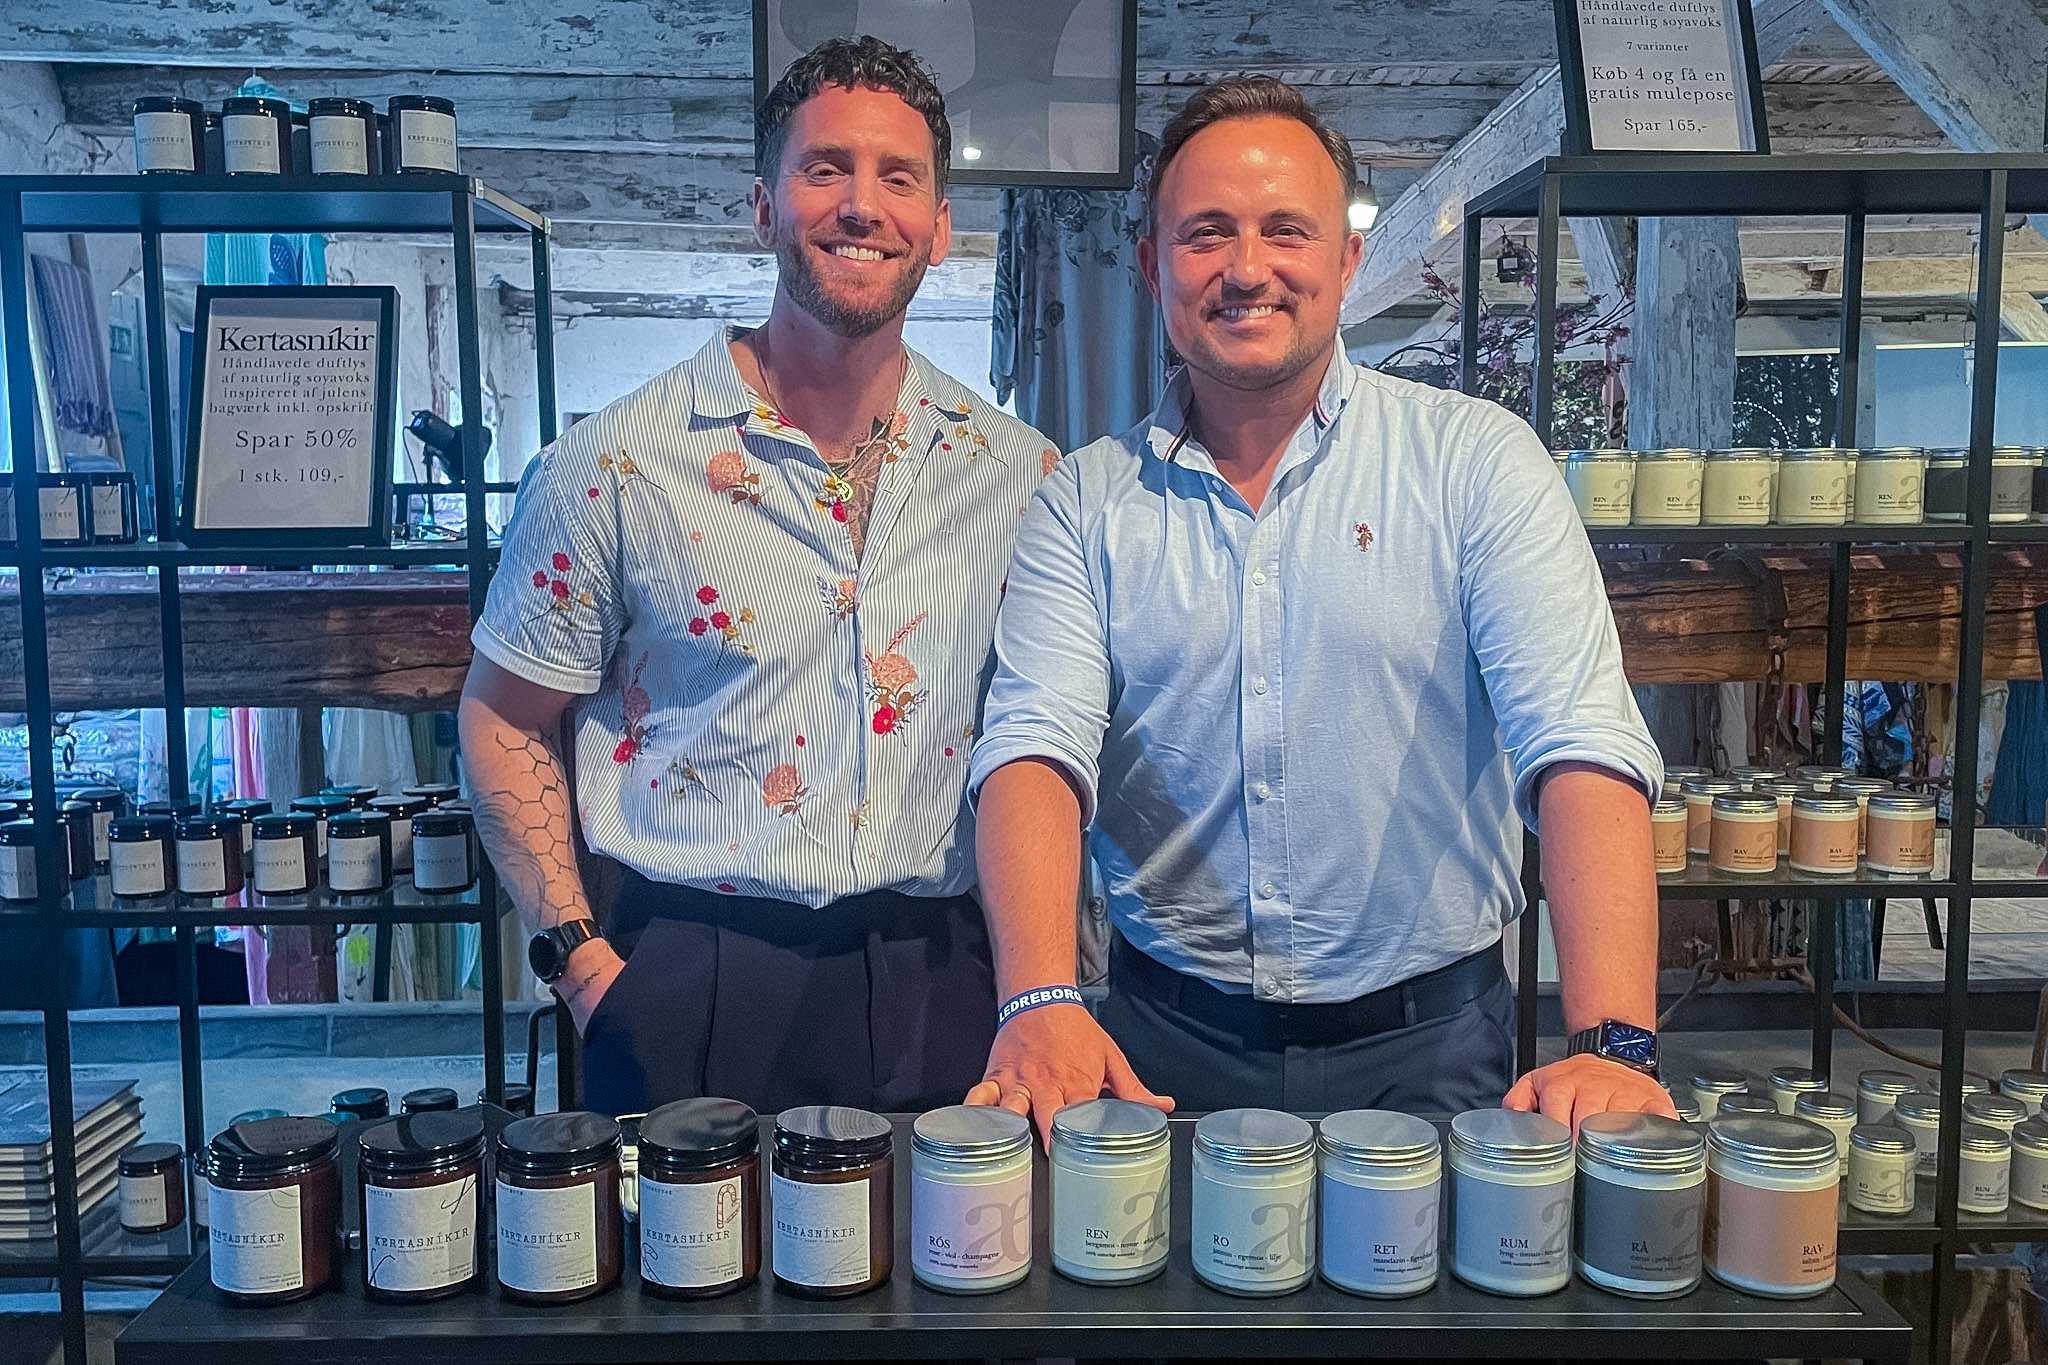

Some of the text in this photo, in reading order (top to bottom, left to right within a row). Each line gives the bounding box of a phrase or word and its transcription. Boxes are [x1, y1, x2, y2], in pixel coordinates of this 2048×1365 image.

[1669, 1, 1715, 15] duftlys
[1583, 15, 1721, 30] af naturlig soyavoks
[1626, 41, 1689, 51] 7 varianter
[1592, 66, 1726, 85] Køb 4 og få en
[1588, 85, 1735, 105] gratis mulepose
[1624, 118, 1708, 134] Spar 165,-
[217, 326, 375, 351] Kertasníkir
[222, 357, 366, 371] Håndlavede duftlys
[222, 372, 370, 385] af naturlig soyavoks
[224, 387, 366, 401] inspireret af julens
[209, 402, 270, 416] bagværk
[277, 402, 310, 413] inkl.
[235, 428, 357, 454] Spar 50%
[240, 468, 345, 483] 1 stk. 109,-
[1086, 1228, 1109, 1239] REN
[1213, 1234, 1230, 1247] RO
[929, 1235, 951, 1249] RÓS
[1500, 1237, 1529, 1249] RUM
[1373, 1244, 1398, 1255] RET
[1802, 1243, 1824, 1256] RAV
